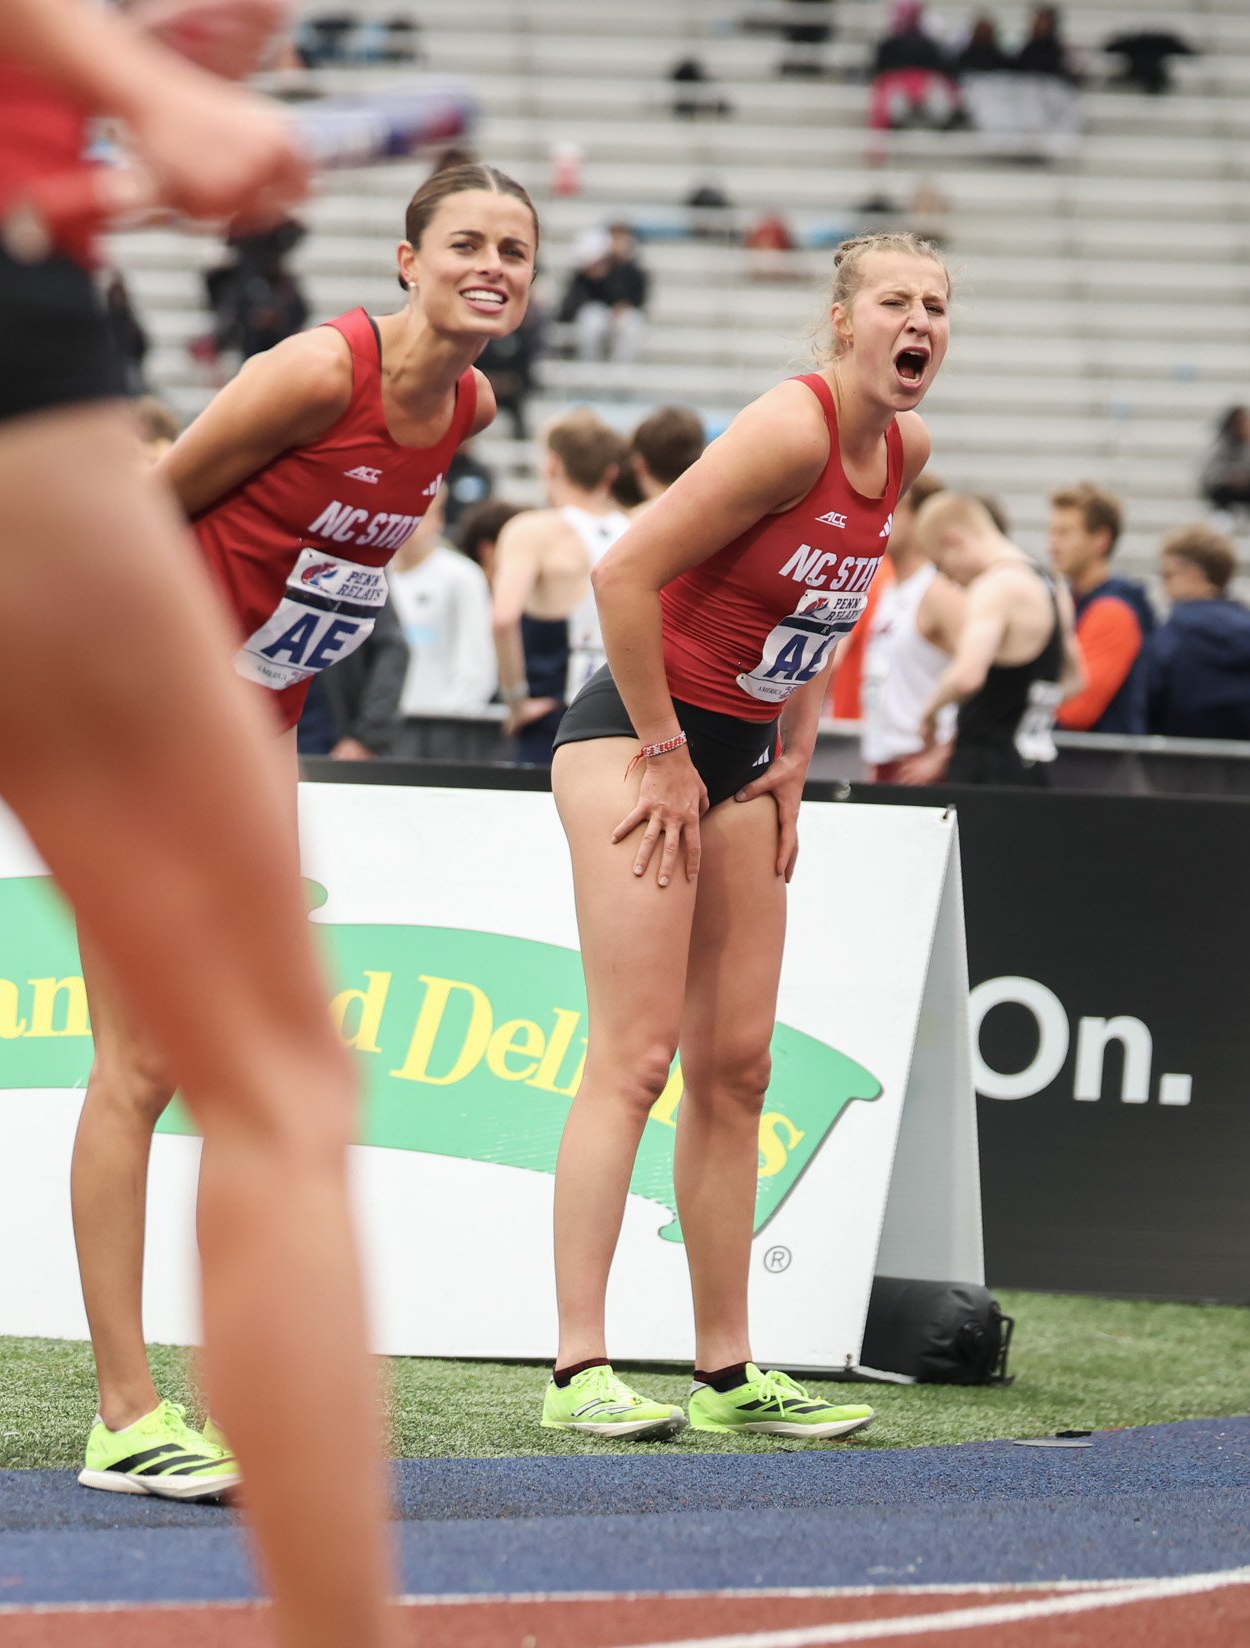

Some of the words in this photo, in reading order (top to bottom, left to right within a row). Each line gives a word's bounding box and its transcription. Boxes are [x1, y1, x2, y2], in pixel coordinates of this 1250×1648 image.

[344, 465, 384, 485] ACC
[307, 500, 369, 542] NC
[814, 511, 848, 529] ACC
[345, 570, 383, 588] PENN
[778, 543, 838, 588] NC
[833, 597, 862, 610] PENN
[260, 612, 361, 670] AE
[968, 975, 1193, 1106] On.
